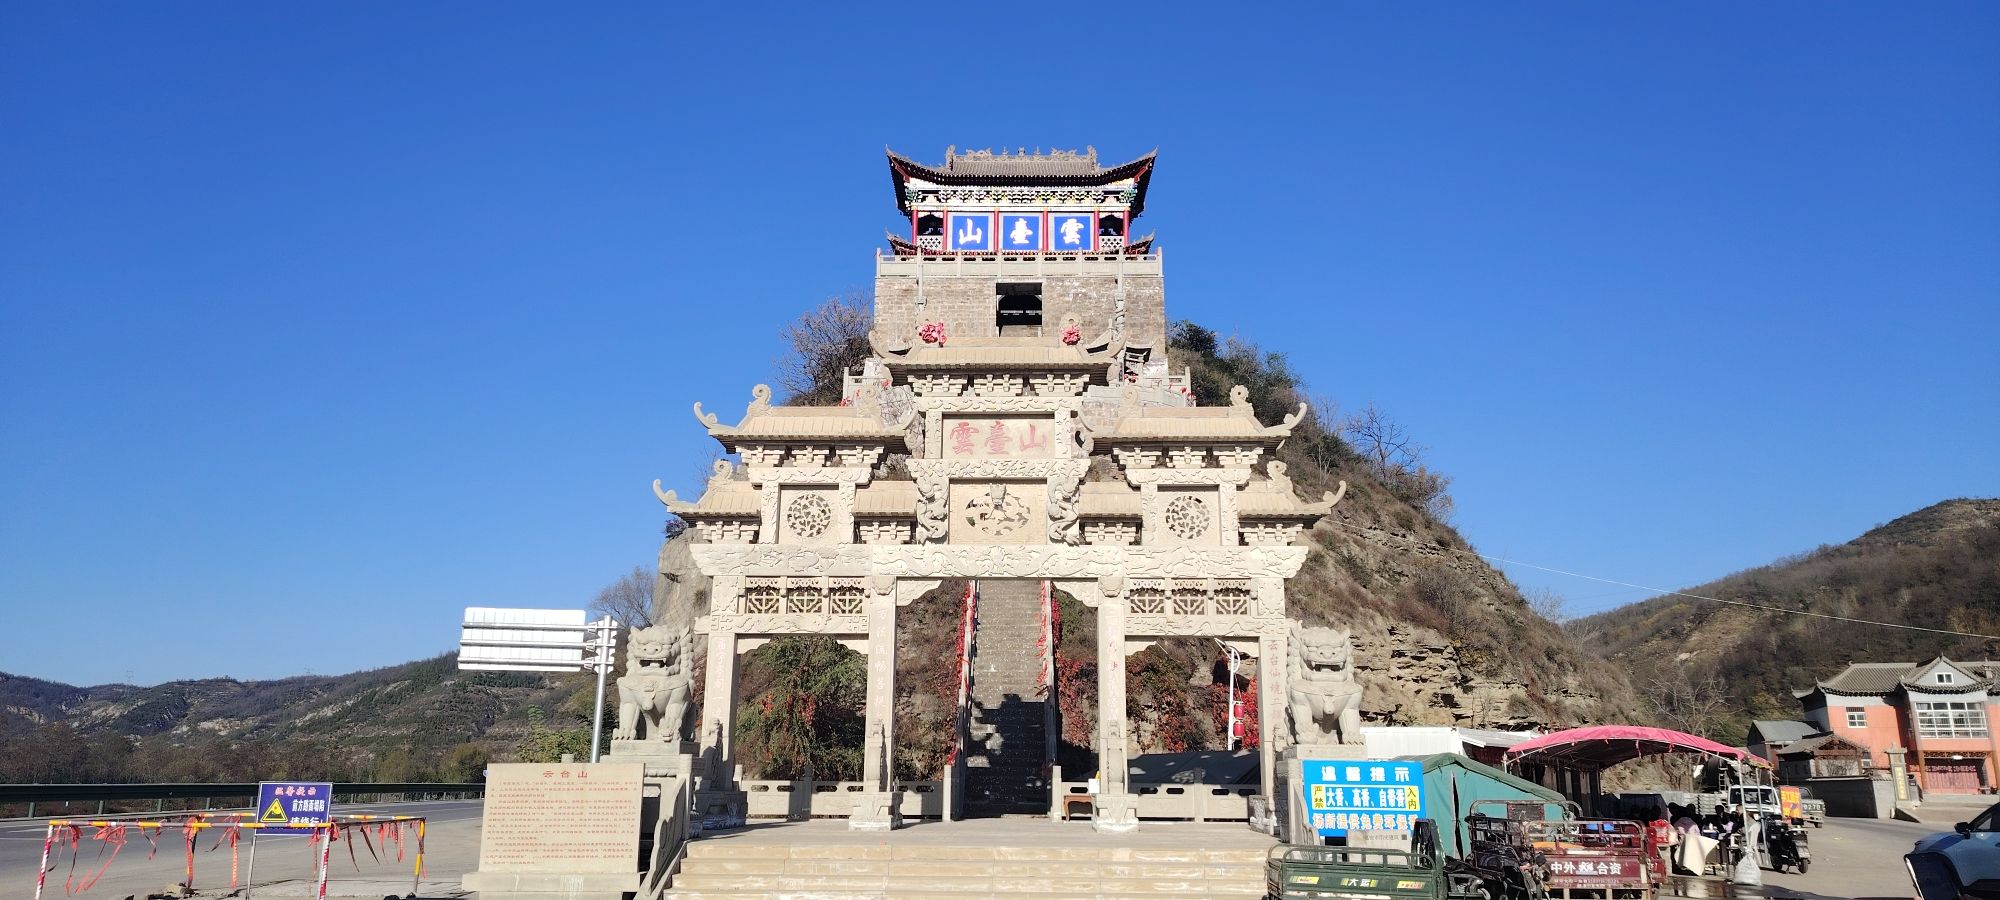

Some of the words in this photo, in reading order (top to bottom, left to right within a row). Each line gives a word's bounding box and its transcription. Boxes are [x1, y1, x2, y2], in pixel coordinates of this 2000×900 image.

[542, 770, 588, 778] 云台山
[1322, 766, 1410, 782] 温馨提示
[1313, 785, 1323, 808] 严禁
[1407, 787, 1417, 809] 入内
